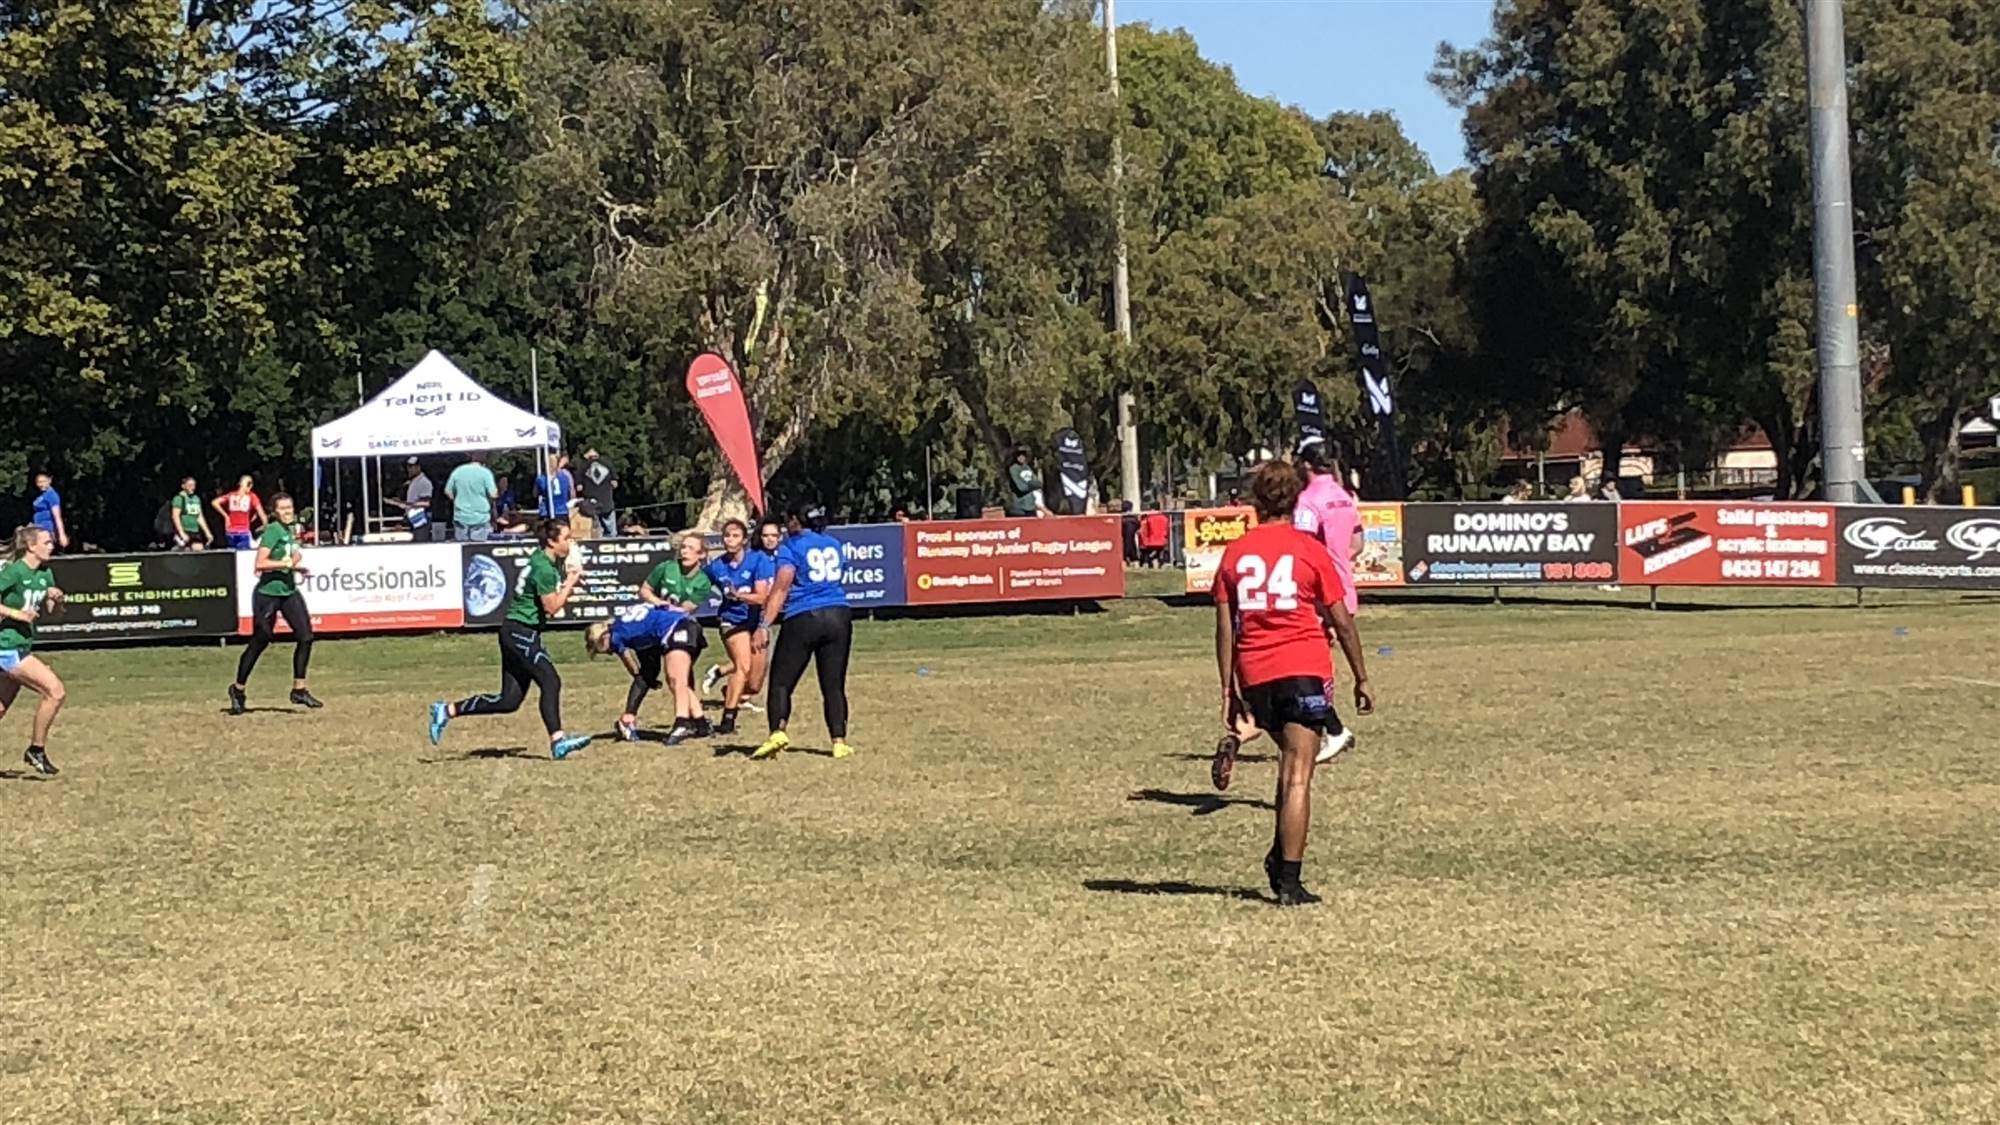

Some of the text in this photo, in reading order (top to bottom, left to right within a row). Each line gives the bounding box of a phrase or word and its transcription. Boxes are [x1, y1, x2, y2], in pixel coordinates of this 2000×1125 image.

[385, 392, 481, 407] Talent ID
[1362, 510, 1396, 524] TS
[1454, 513, 1569, 531] DOMINO'S
[917, 527, 1021, 543] Proud sponsors of
[1428, 534, 1595, 553] RUNAWAY BAY
[598, 542, 671, 553] CLEAR
[917, 540, 1113, 558] Runaway Bay Junior Rugby League
[807, 547, 842, 582] 92
[1722, 560, 1762, 578] 0433
[1790, 560, 1821, 577] 294
[1235, 554, 1298, 610] 24
[124, 587, 228, 601] ENGINEERING
